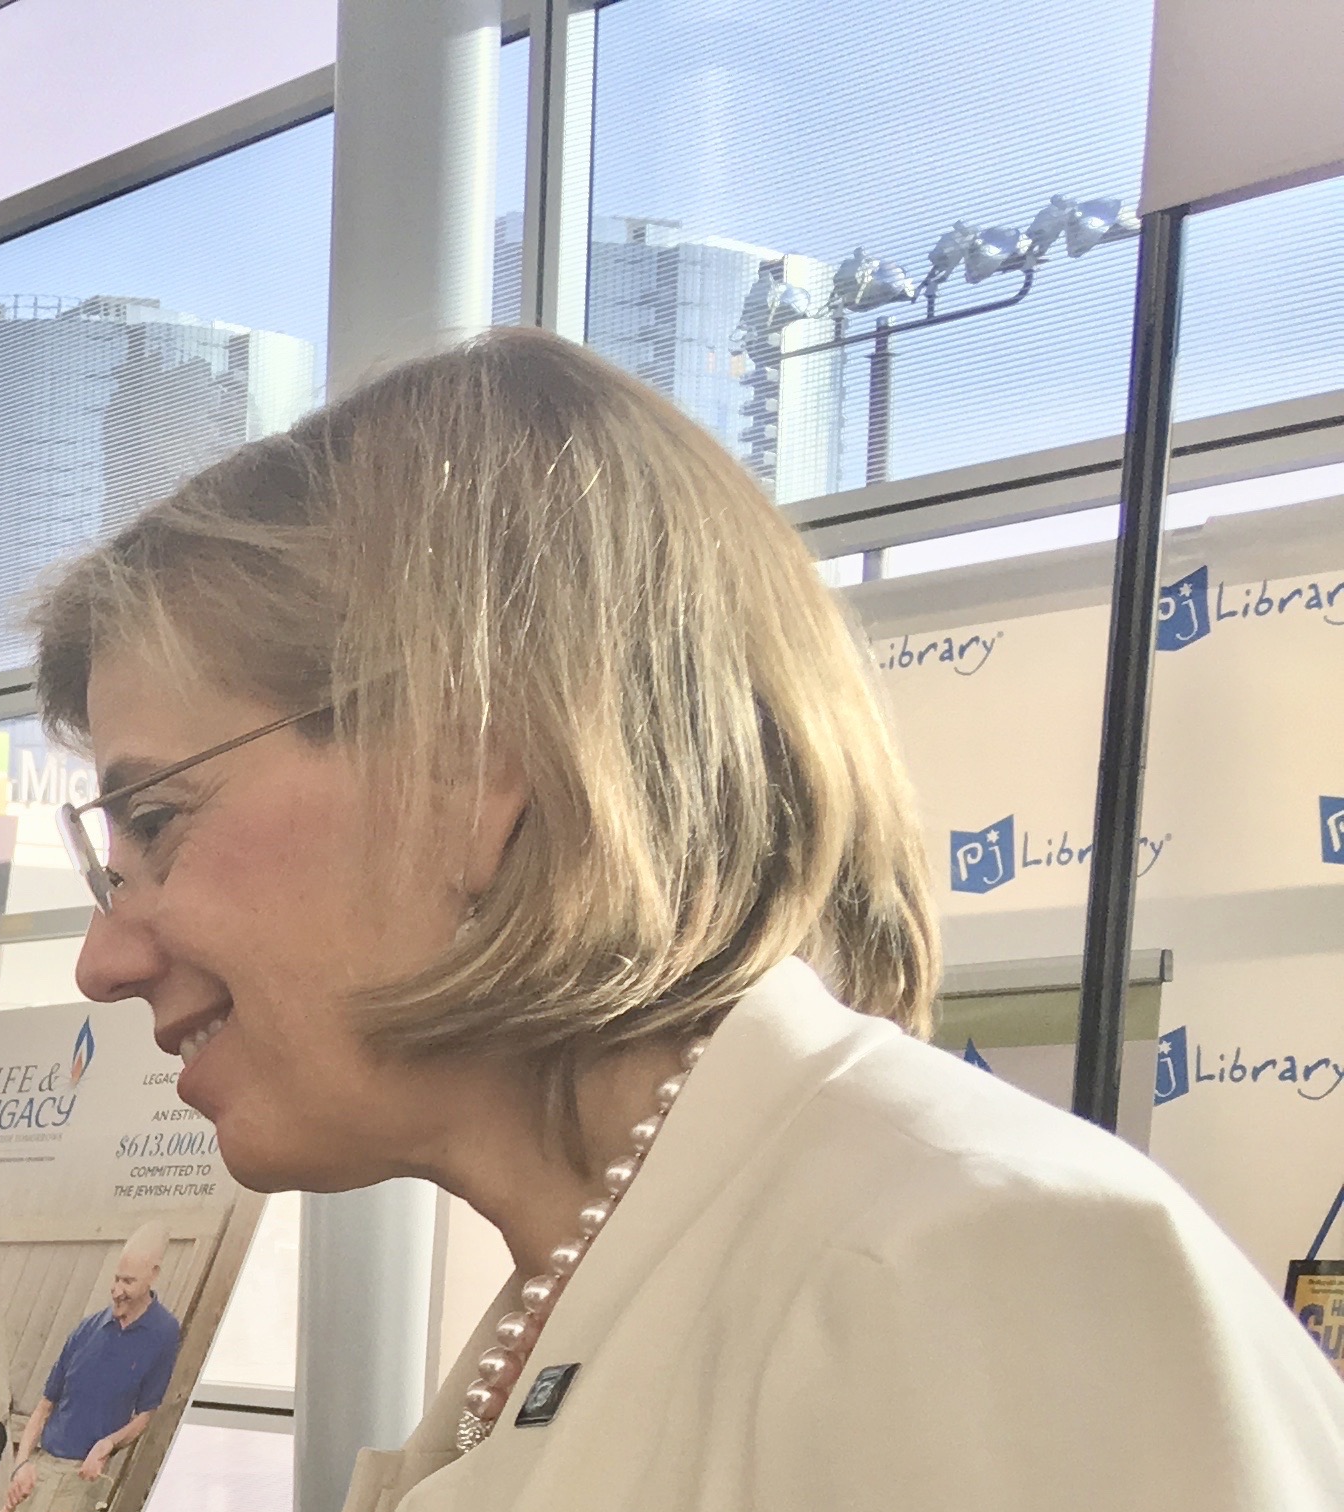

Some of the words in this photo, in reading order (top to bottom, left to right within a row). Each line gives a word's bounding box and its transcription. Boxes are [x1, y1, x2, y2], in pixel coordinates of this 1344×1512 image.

[879, 635, 994, 676] ibrary
[1022, 831, 1163, 877] Libry
[38, 1062, 61, 1092] &
[143, 1072, 179, 1086] LEGAC
[1196, 1044, 1344, 1100] Library
[151, 1110, 169, 1121] AN
[130, 1165, 193, 1178] COMMITTED
[196, 1164, 212, 1177] TO
[114, 1185, 133, 1197] THE
[133, 1185, 172, 1199] JEWISH
[173, 1183, 216, 1196] FUTURE
